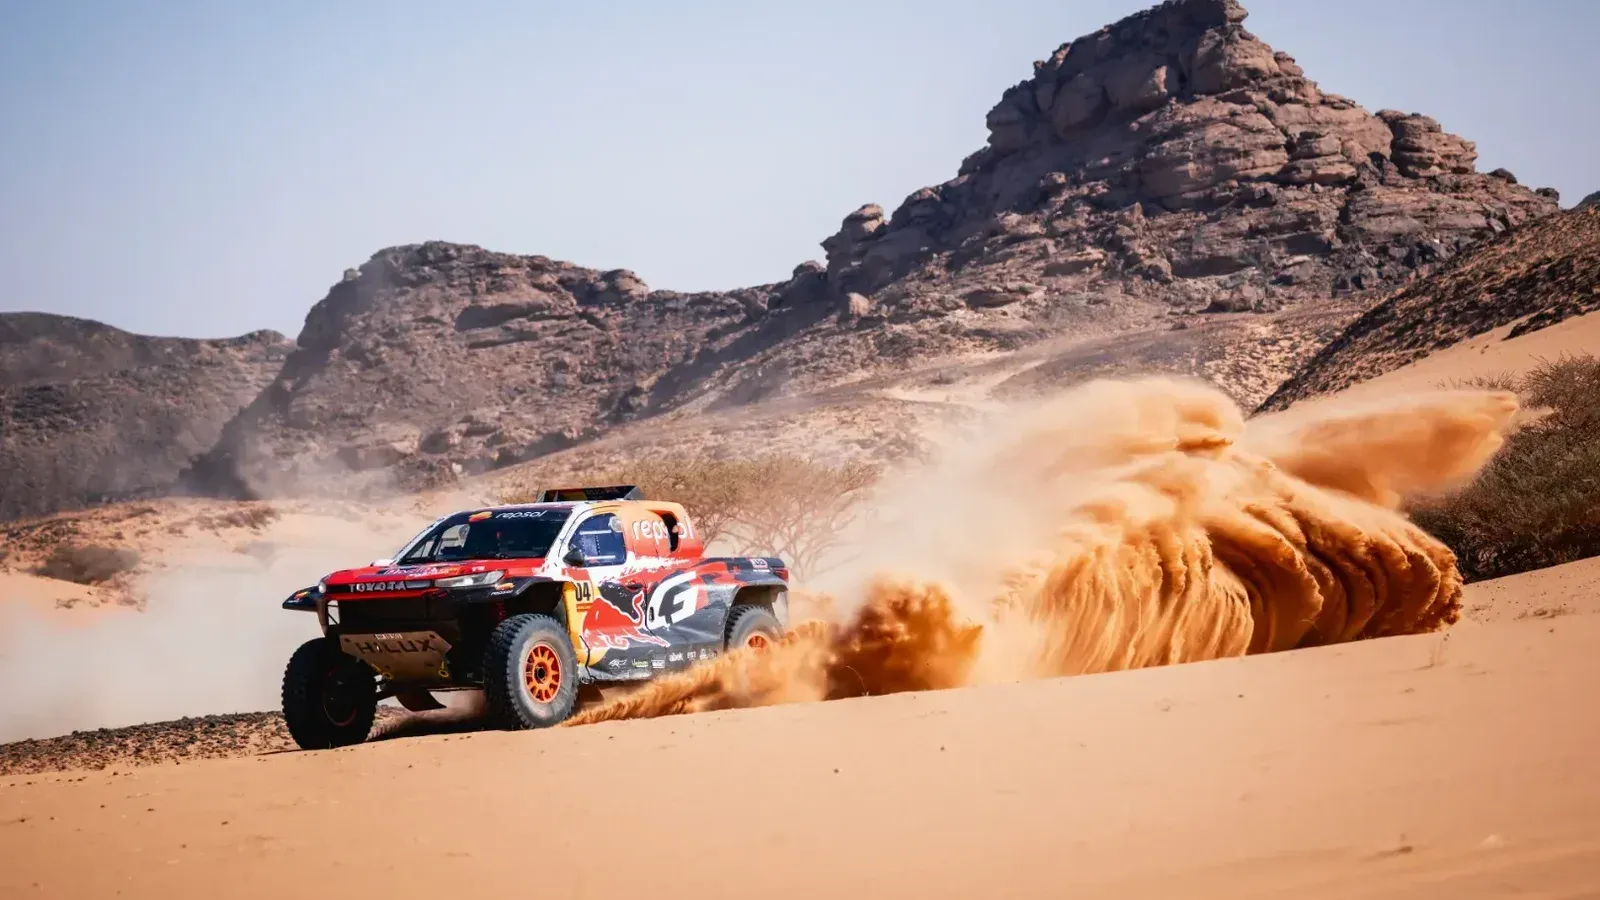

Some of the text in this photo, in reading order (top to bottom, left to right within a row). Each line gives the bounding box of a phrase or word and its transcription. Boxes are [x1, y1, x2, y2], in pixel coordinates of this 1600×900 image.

[495, 510, 548, 520] repsol
[349, 581, 406, 592] TOYOTA
[575, 582, 591, 601] 04
[355, 638, 436, 654] HILUX
